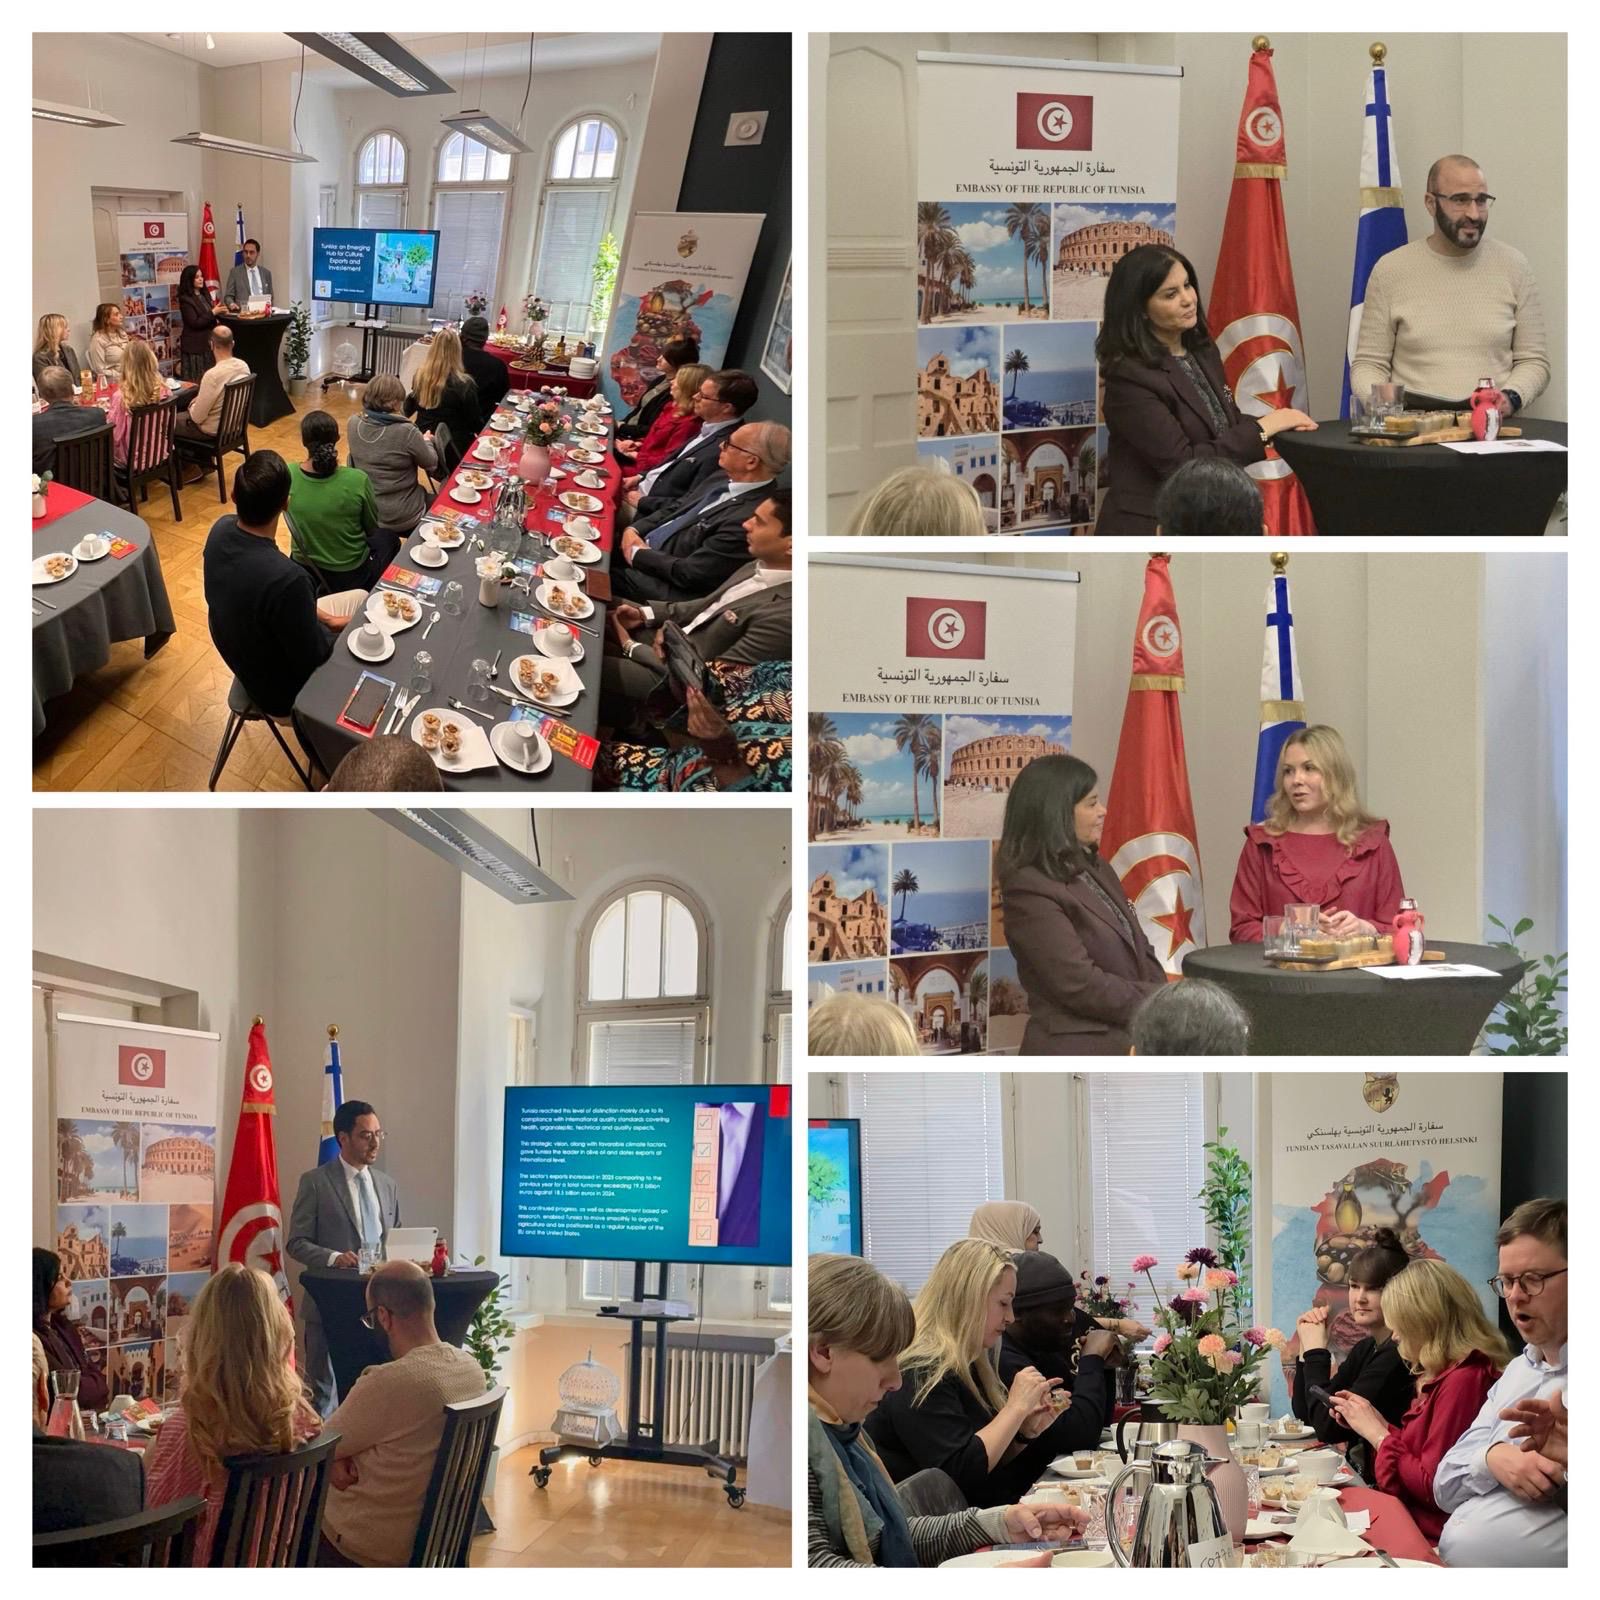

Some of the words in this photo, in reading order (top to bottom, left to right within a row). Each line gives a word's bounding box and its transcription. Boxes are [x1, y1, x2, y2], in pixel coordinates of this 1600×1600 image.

[990, 159, 1031, 176] التونسية
[1034, 160, 1083, 176] الجمهورية
[1086, 162, 1116, 177] سفارة
[956, 184, 1001, 193] EMBASSY
[1004, 185, 1018, 193] OF
[1020, 185, 1041, 194] THE
[1043, 185, 1091, 194] REPUBLIC
[1092, 186, 1106, 194] OF
[1108, 186, 1146, 195] TUNISIA
[347, 244, 371, 252] Emerging
[878, 667, 921, 685] التونسية
[925, 669, 976, 686] الجمهورية
[979, 672, 1009, 687] سفارة
[842, 694, 890, 704] EMBASSY
[893, 695, 908, 704] OF
[910, 695, 931, 704] THE
[933, 696, 982, 705] REPUBLIC
[985, 697, 999, 705] OF
[1002, 697, 1041, 706] TUNISIA
[81, 1107, 110, 1115] EMBASSY
[134, 1110, 164, 1118] REPUBLIC
[521, 1116, 552, 1124] compliance
[614, 1124, 632, 1132] quality
[1344, 1125, 1375, 1137] التونسية
[1378, 1123, 1416, 1136] الجمهورية
[1419, 1122, 1444, 1134] سفارة
[530, 1140, 552, 1148] strategic
[570, 1140, 586, 1148] along
[1321, 1143, 1368, 1151] TASAVALLAN
[1439, 1137, 1478, 1145] HELSINKI
[636, 1149, 655, 1157] exports
[549, 1173, 568, 1181] exports
[615, 1174, 645, 1182] comparing
[519, 1181, 541, 1189] previous
[603, 1182, 632, 1190] exceeding
[534, 1189, 553, 1197] against
[606, 1215, 630, 1223] smoothly
[638, 1216, 659, 1224] organic
